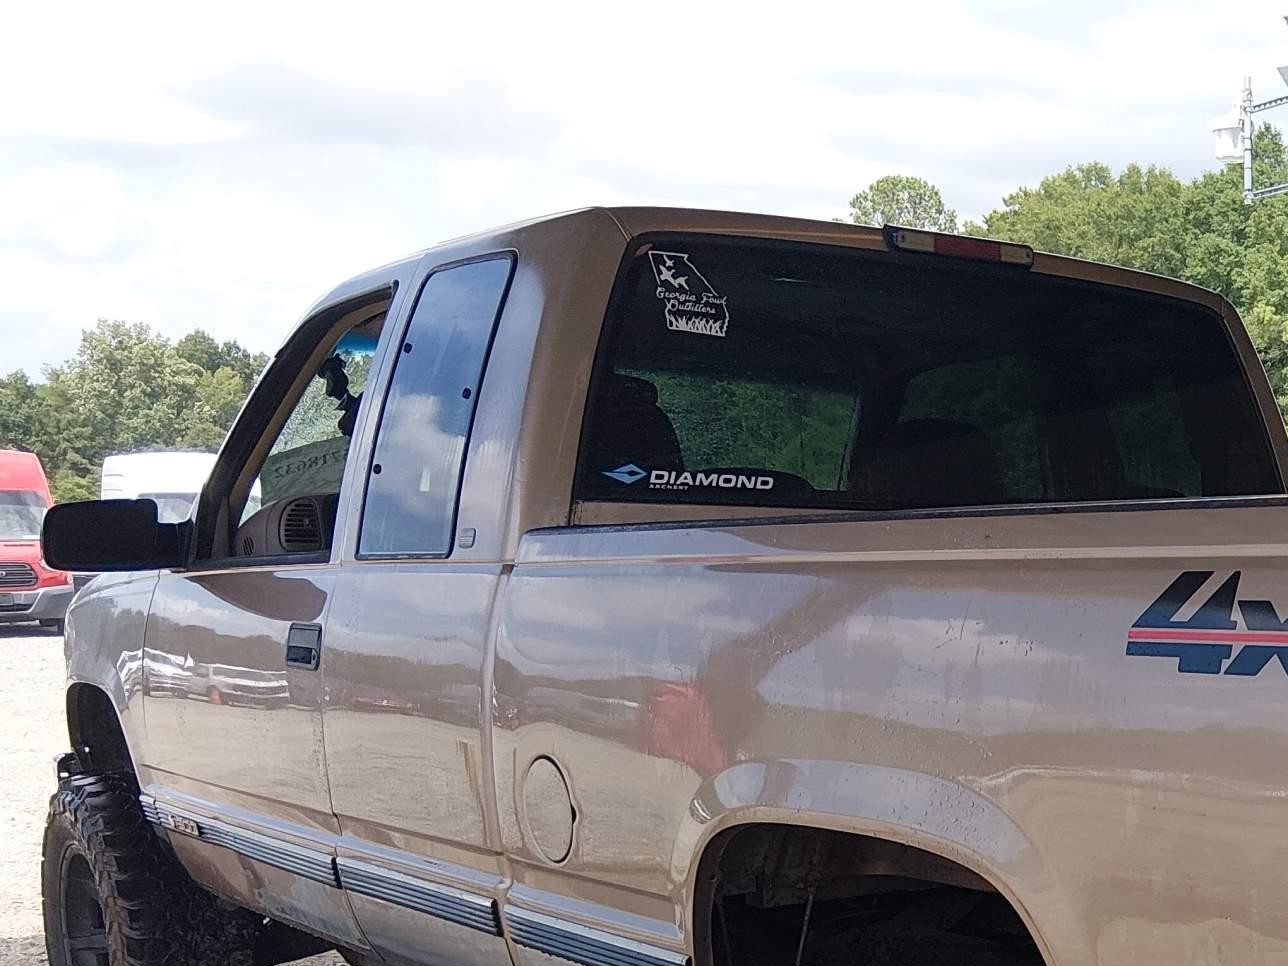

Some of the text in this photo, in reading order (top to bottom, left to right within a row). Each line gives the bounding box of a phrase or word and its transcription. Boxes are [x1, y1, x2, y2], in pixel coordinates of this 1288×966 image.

[656, 286, 727, 304] Georgia Fowl
[669, 299, 716, 314] Outfitters
[649, 470, 774, 490] DIAMOND
